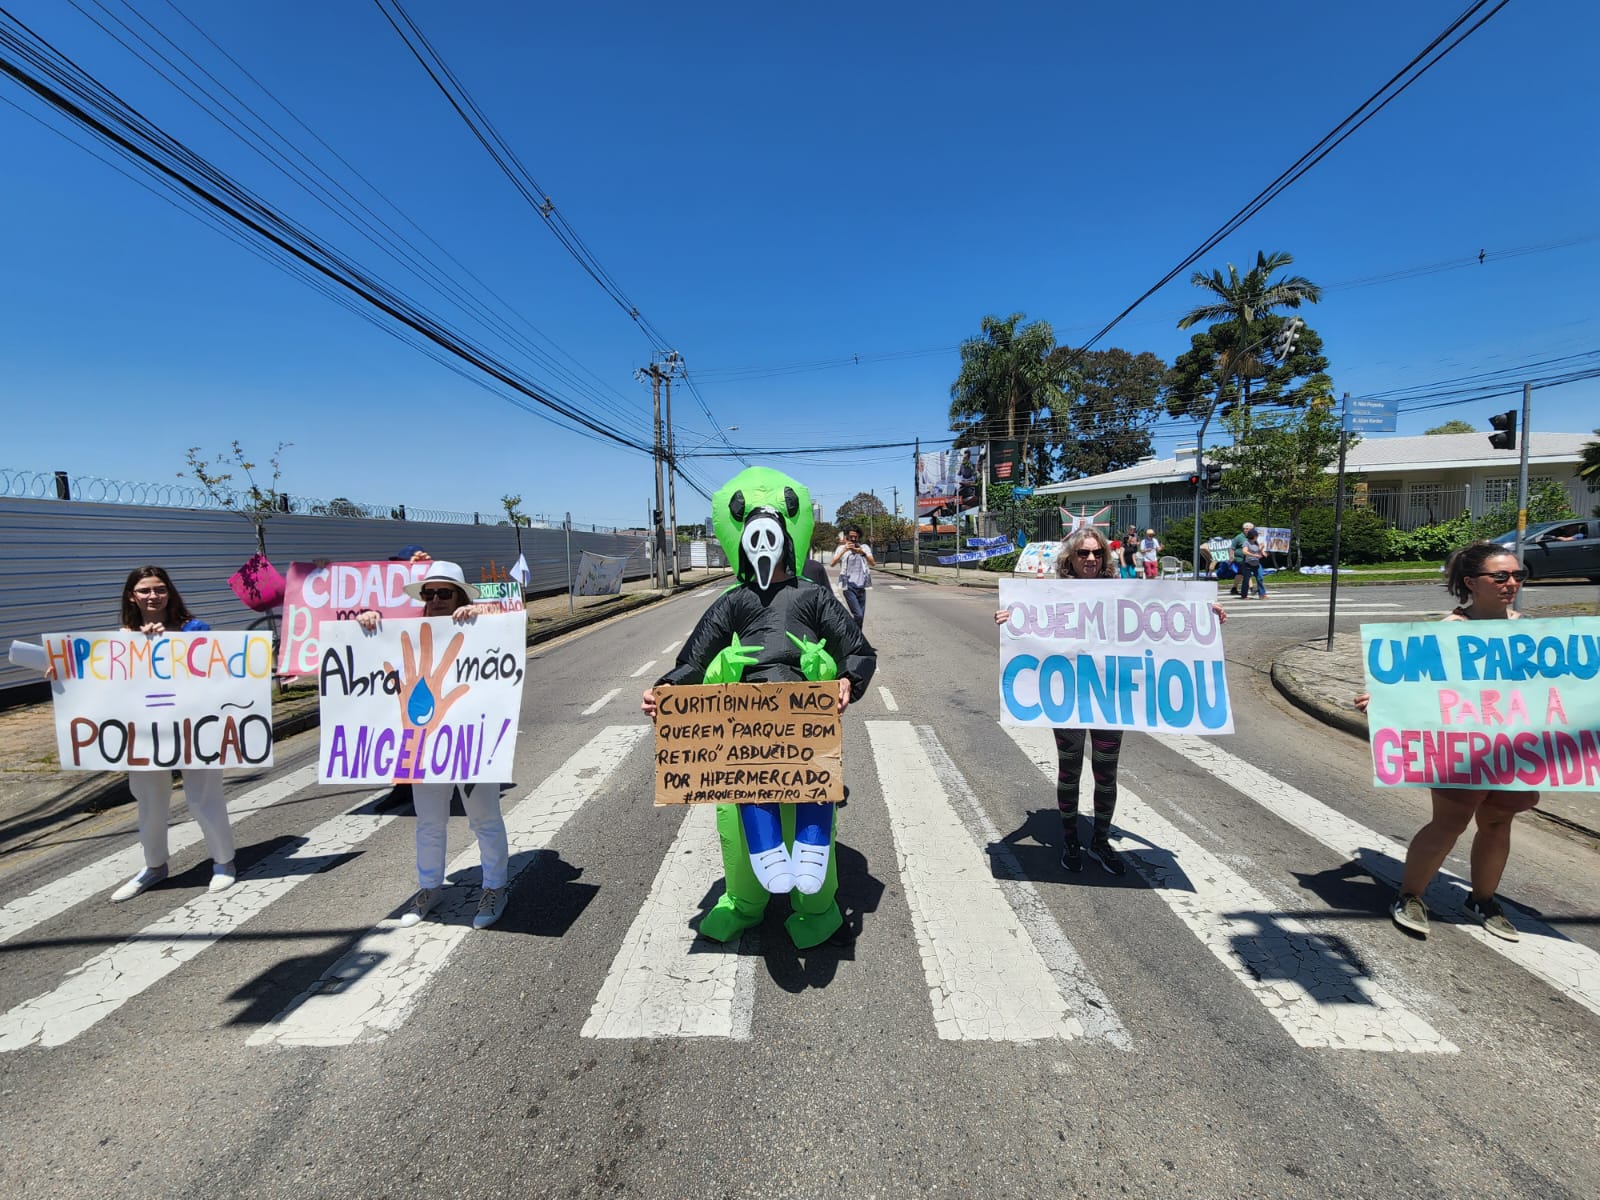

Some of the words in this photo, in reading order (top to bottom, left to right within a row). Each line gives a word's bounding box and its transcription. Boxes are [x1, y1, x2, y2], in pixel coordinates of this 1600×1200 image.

[500, 583, 520, 598] SIM
[500, 598, 522, 613] NÃO
[1006, 601, 1106, 641] QUEM
[1117, 599, 1217, 645] DOOU
[320, 645, 402, 697] Abra
[456, 647, 523, 686] mão,
[1368, 634, 1447, 684] UM
[1457, 633, 1600, 682] PARQU
[145, 692, 176, 708] =
[789, 685, 835, 711] NÃO
[1438, 688, 1531, 725] PARA
[1545, 686, 1568, 724] A
[70, 700, 273, 768] POLUIÇÃO
[659, 723, 725, 741] QUEREM
[802, 723, 835, 738] BOM
[727, 742, 814, 762] ABDUZIDO
[1373, 728, 1600, 787] GENEROSIDA
[664, 771, 690, 789] POR
